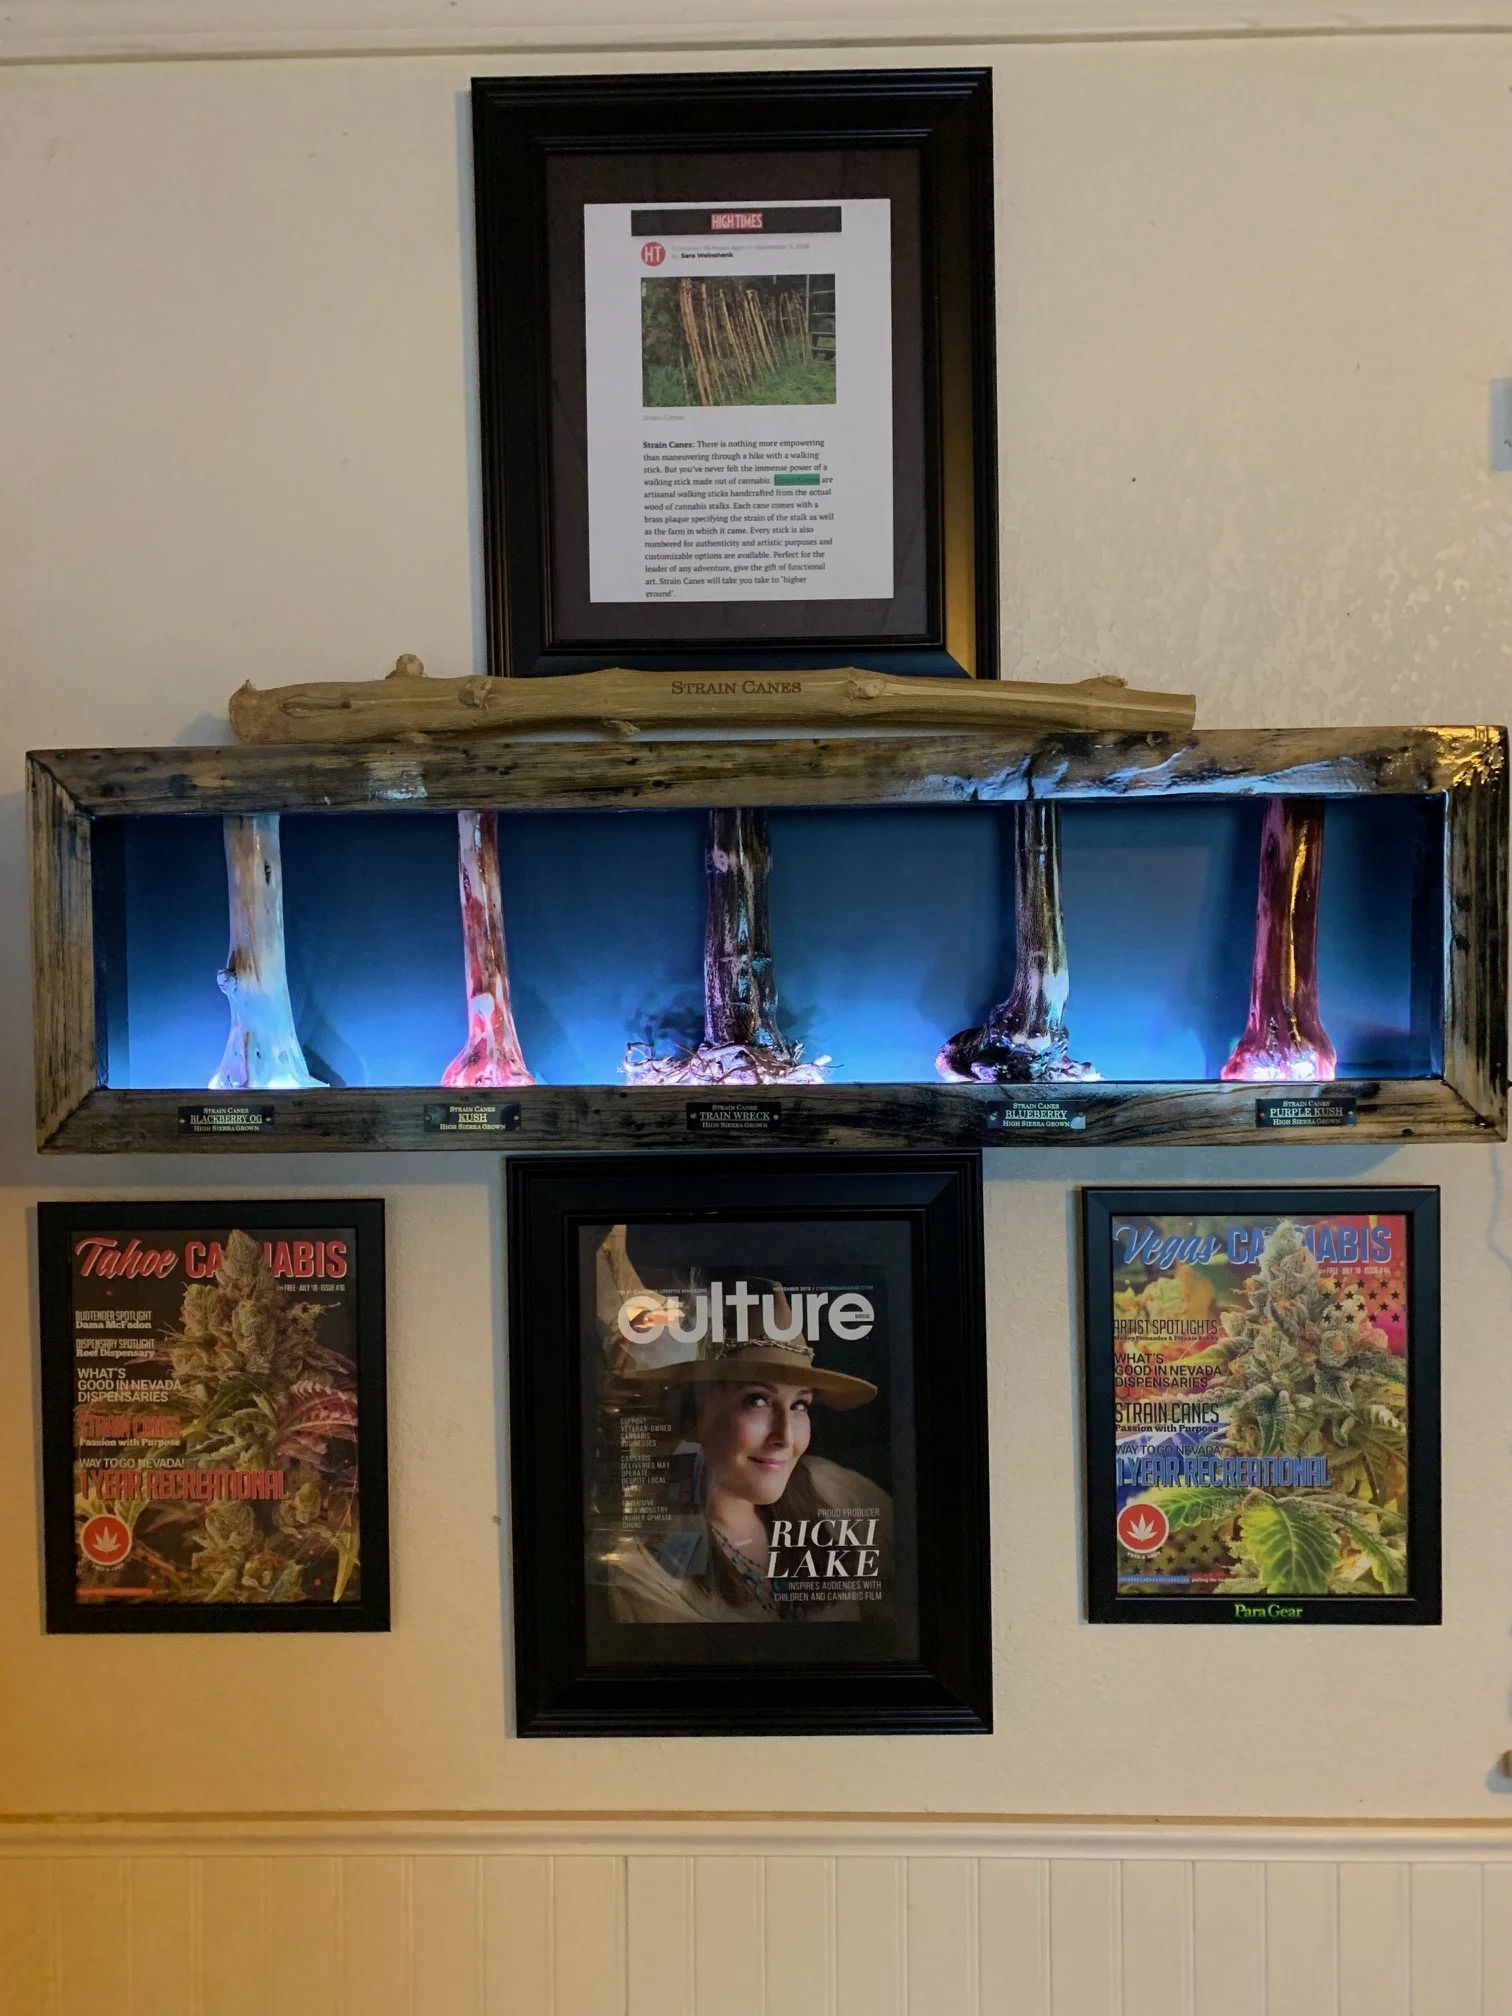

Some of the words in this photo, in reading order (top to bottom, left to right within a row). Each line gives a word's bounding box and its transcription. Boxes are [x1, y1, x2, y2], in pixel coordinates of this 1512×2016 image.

[712, 214, 734, 229] HIGH
[735, 214, 763, 228] TIMES
[644, 246, 661, 262] HT
[728, 440, 757, 449] nothing
[780, 439, 824, 448] empowering
[661, 453, 710, 463] maneuvering
[711, 452, 741, 462] through
[790, 451, 819, 461] walking
[677, 490, 706, 500] walking
[695, 539, 740, 549] authenticity
[784, 540, 817, 548] purposes
[694, 552, 722, 561] options
[672, 681, 736, 695] STRAIN
[742, 680, 802, 693] CANES
[1005, 1110, 1067, 1118] BLUEBERRY
[1270, 1108, 1311, 1117] PURPLE
[1314, 1107, 1343, 1116] KUSH
[190, 1115, 248, 1123] BLACKBERRY
[250, 1115, 262, 1123] OG
[1113, 1224, 1222, 1270] Vegas
[75, 1237, 179, 1279] Tahoe
[76, 1311, 114, 1321] BUDTENDER
[116, 1311, 152, 1321] SPOTLIGHT
[618, 1281, 875, 1344] culture
[1114, 1319, 1150, 1334] ARTIST
[1153, 1319, 1217, 1334] SPOTLIGHTS
[76, 1339, 117, 1349] DISPENSARY
[119, 1339, 155, 1349] SPOTLIGHT
[100, 1349, 155, 1358] Dispensary
[1114, 1353, 1163, 1364] WHAT'S
[77, 1368, 126, 1378] WHAT'S
[1115, 1365, 1151, 1376] GOOD
[1155, 1365, 1166, 1376] IN
[1170, 1365, 1221, 1376] NEVADA
[78, 1380, 114, 1390] GOOD
[117, 1380, 128, 1390] IN
[132, 1380, 181, 1390] NEVADA
[1115, 1377, 1208, 1388] DISPENSARIES
[78, 1392, 168, 1402] DISPENSARIES
[1116, 1403, 1167, 1423] STRAIN
[1171, 1403, 1219, 1423] CANES
[1179, 1424, 1218, 1433] Purpose
[142, 1438, 180, 1447] Purpose
[1116, 1446, 1139, 1455] WAY
[1142, 1446, 1155, 1455] TO
[1157, 1446, 1173, 1455] GO
[1177, 1446, 1224, 1455] NEVADA!
[80, 1458, 102, 1468] WAY
[103, 1458, 118, 1468] TO
[119, 1458, 135, 1468] GO
[138, 1458, 184, 1468] NEVADA!
[1127, 1457, 1180, 1487] YEAR
[1184, 1457, 1332, 1487] RECREATIONAL
[80, 1470, 89, 1500] 1
[90, 1470, 142, 1500] YEAR
[147, 1470, 290, 1500] RECREATIONAL
[818, 1509, 841, 1517] PROUD
[843, 1508, 880, 1517] PRODUCER
[768, 1519, 880, 1547] RICKI
[765, 1550, 880, 1578] LAKE
[789, 1582, 819, 1590] INSPIRES
[823, 1581, 861, 1590] AUDIENCES
[863, 1581, 881, 1589] WITH
[774, 1593, 808, 1601] CHILDREN
[811, 1593, 825, 1601] AND
[828, 1592, 863, 1600] CANNABIS
[865, 1592, 882, 1600] FILM
[1234, 1604, 1266, 1618] Para
[1268, 1604, 1303, 1618] Gear
